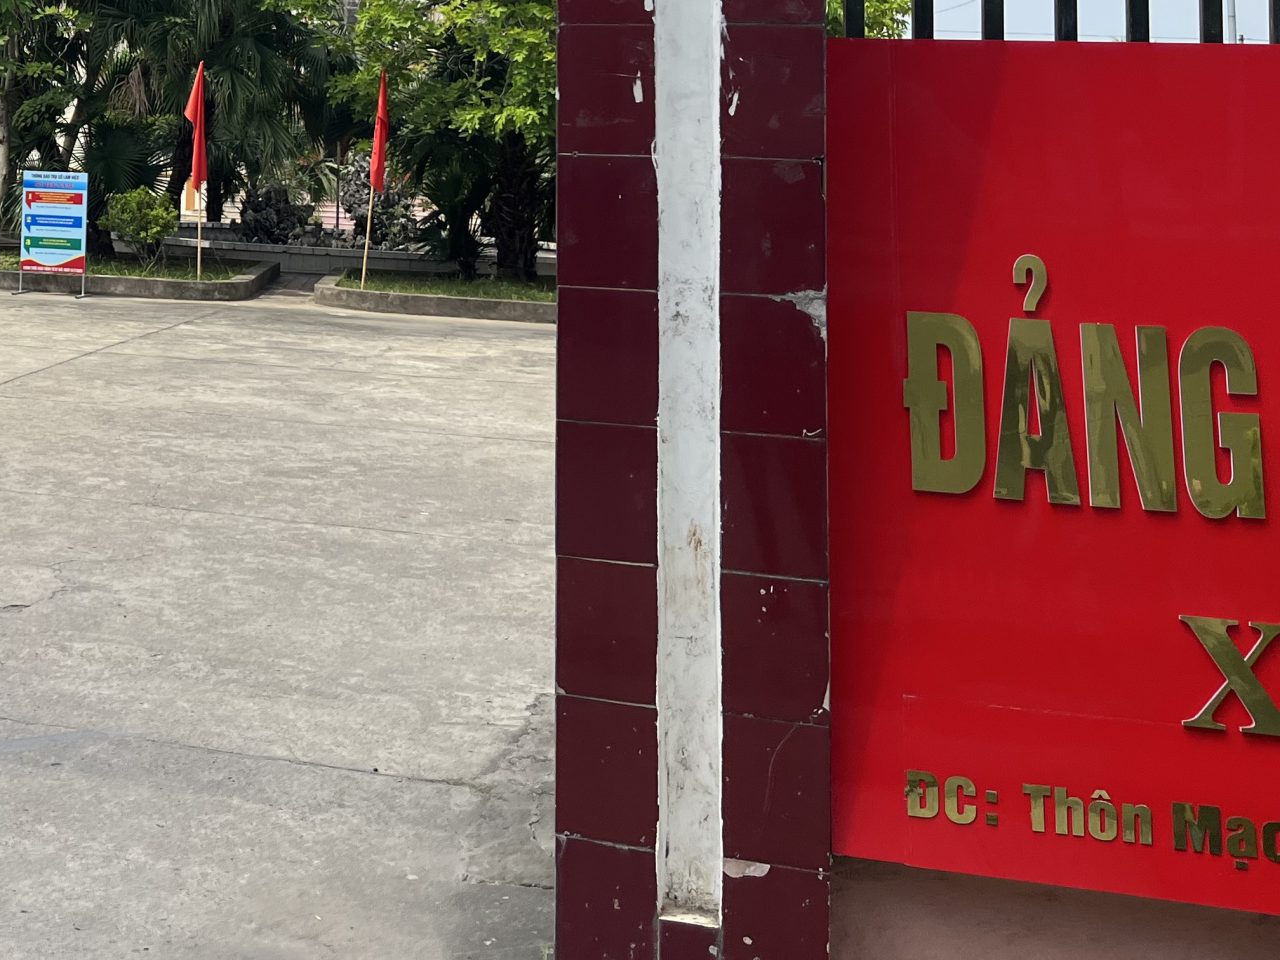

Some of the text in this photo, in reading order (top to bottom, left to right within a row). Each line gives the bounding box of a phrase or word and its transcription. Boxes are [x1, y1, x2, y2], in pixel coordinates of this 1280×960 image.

[903, 254, 1266, 520] ĐẢNG
[904, 769, 999, 826] ĐC:
[1022, 783, 1154, 846] Thôn
